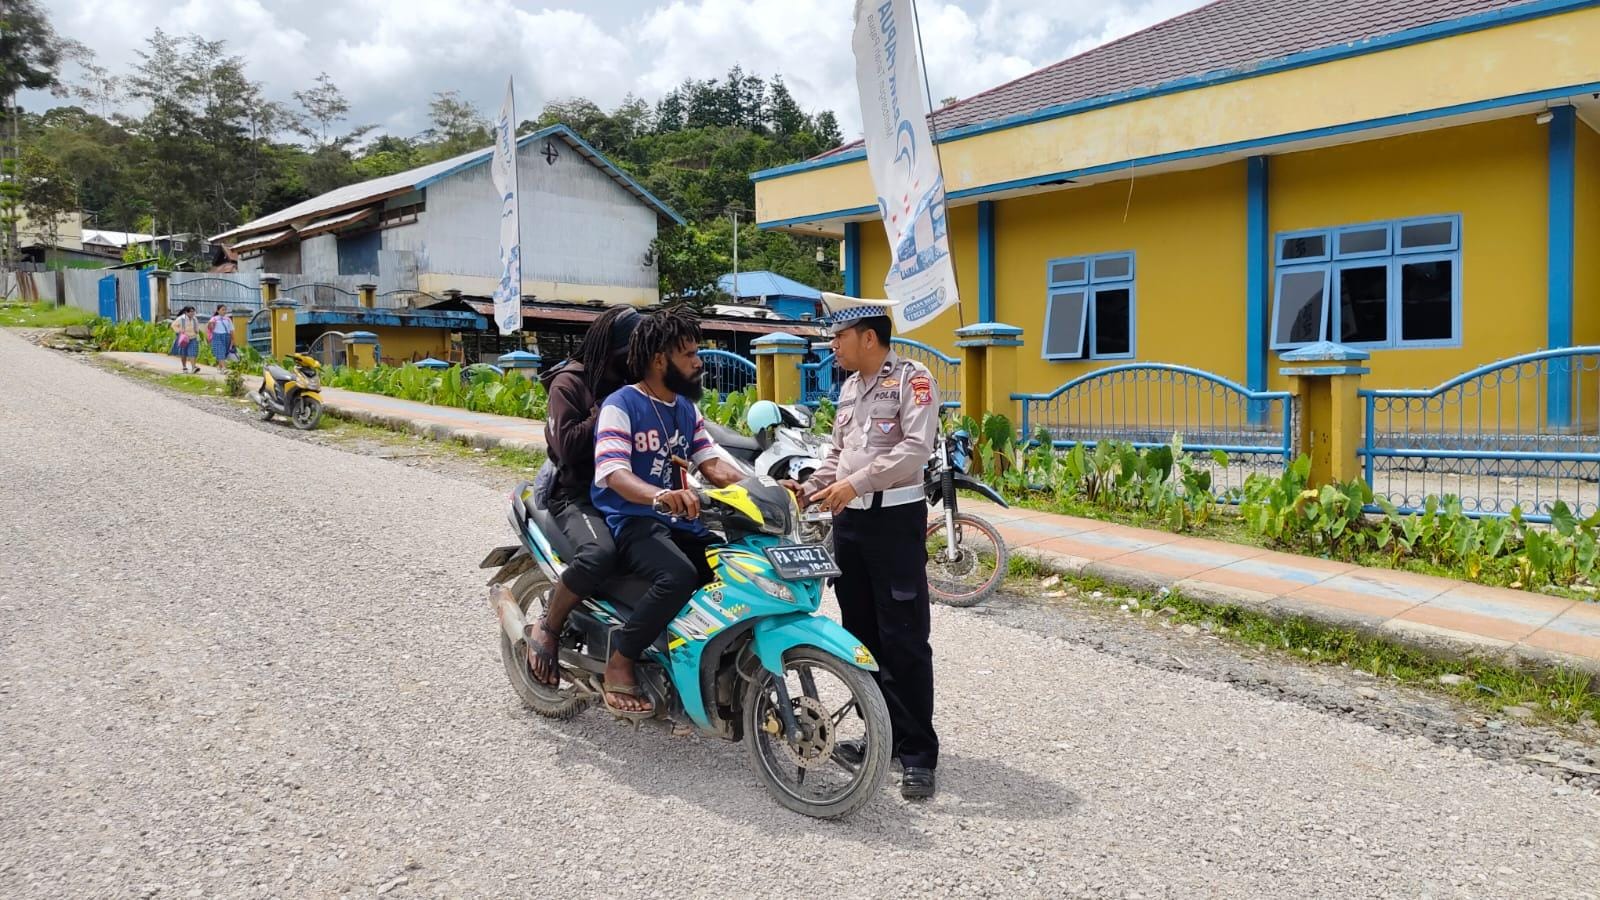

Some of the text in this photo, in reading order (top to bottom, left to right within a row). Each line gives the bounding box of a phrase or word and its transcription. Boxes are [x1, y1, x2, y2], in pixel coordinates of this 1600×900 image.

[874, 390, 900, 401] POLRI
[635, 429, 660, 452] 86
[773, 548, 825, 564] PA 3402 Z
